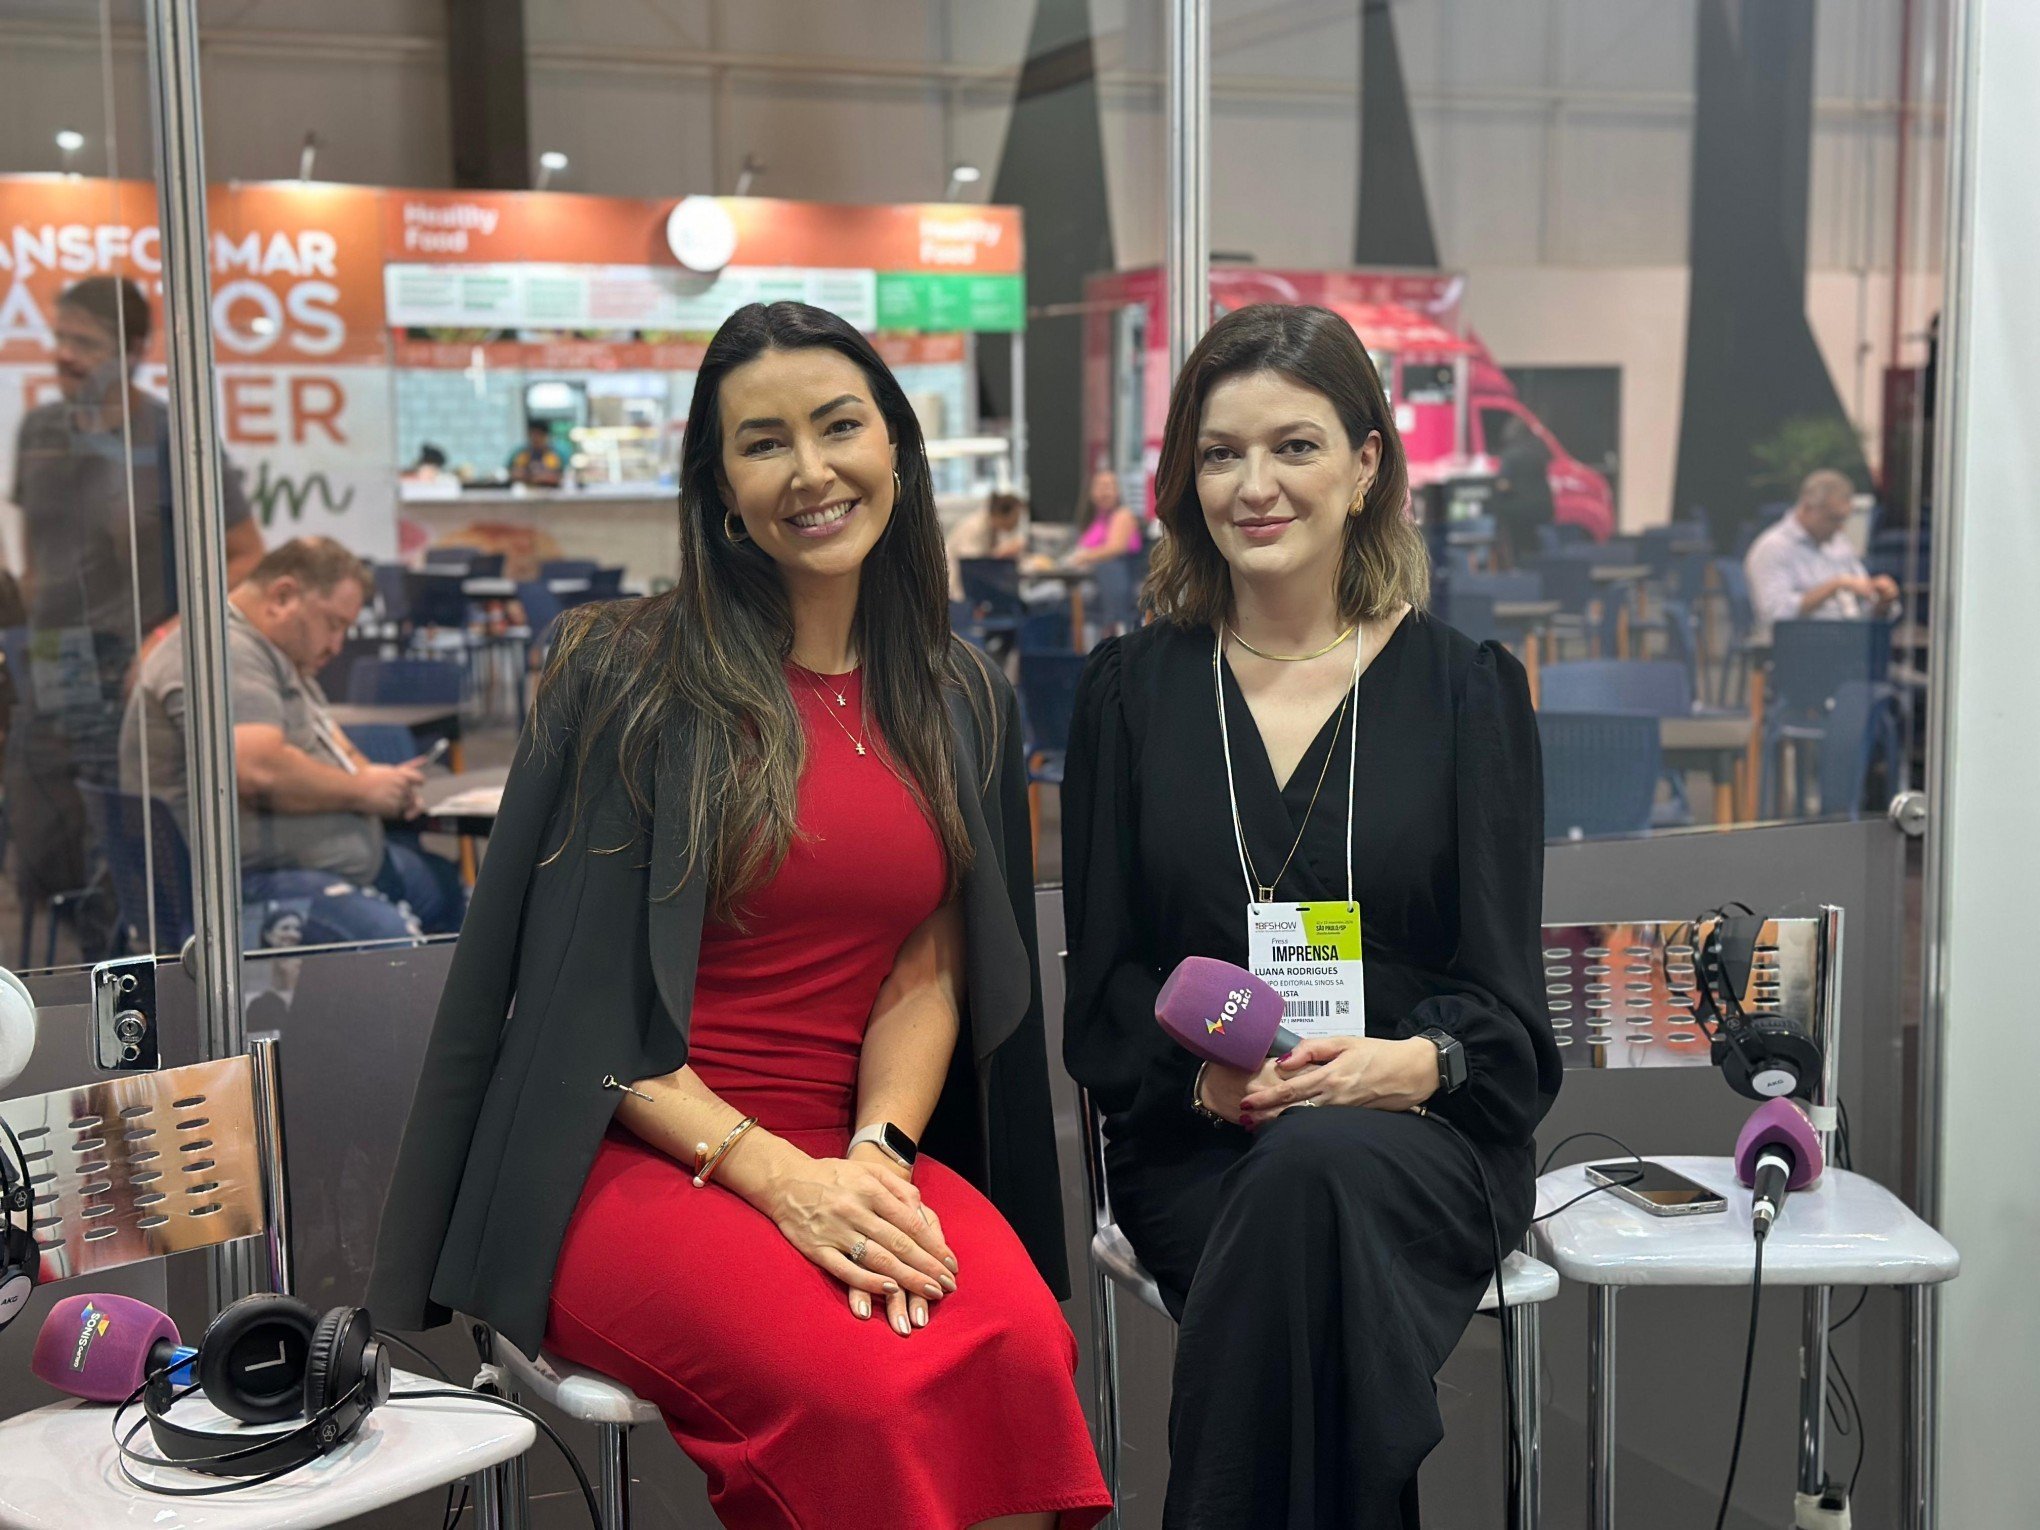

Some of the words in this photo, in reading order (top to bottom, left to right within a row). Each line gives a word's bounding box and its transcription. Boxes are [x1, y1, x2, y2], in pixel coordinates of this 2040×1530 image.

[403, 202, 499, 236] Healthy
[404, 224, 468, 252] Food
[920, 240, 976, 265] Food
[1271, 937, 1288, 945] Press
[1272, 945, 1339, 962] IMPRENSA
[1255, 968, 1285, 976] LUANA
[1287, 967, 1338, 975] RODRIGUES
[1767, 1079, 1784, 1087] AKG
[78, 1312, 101, 1347] SINOS
